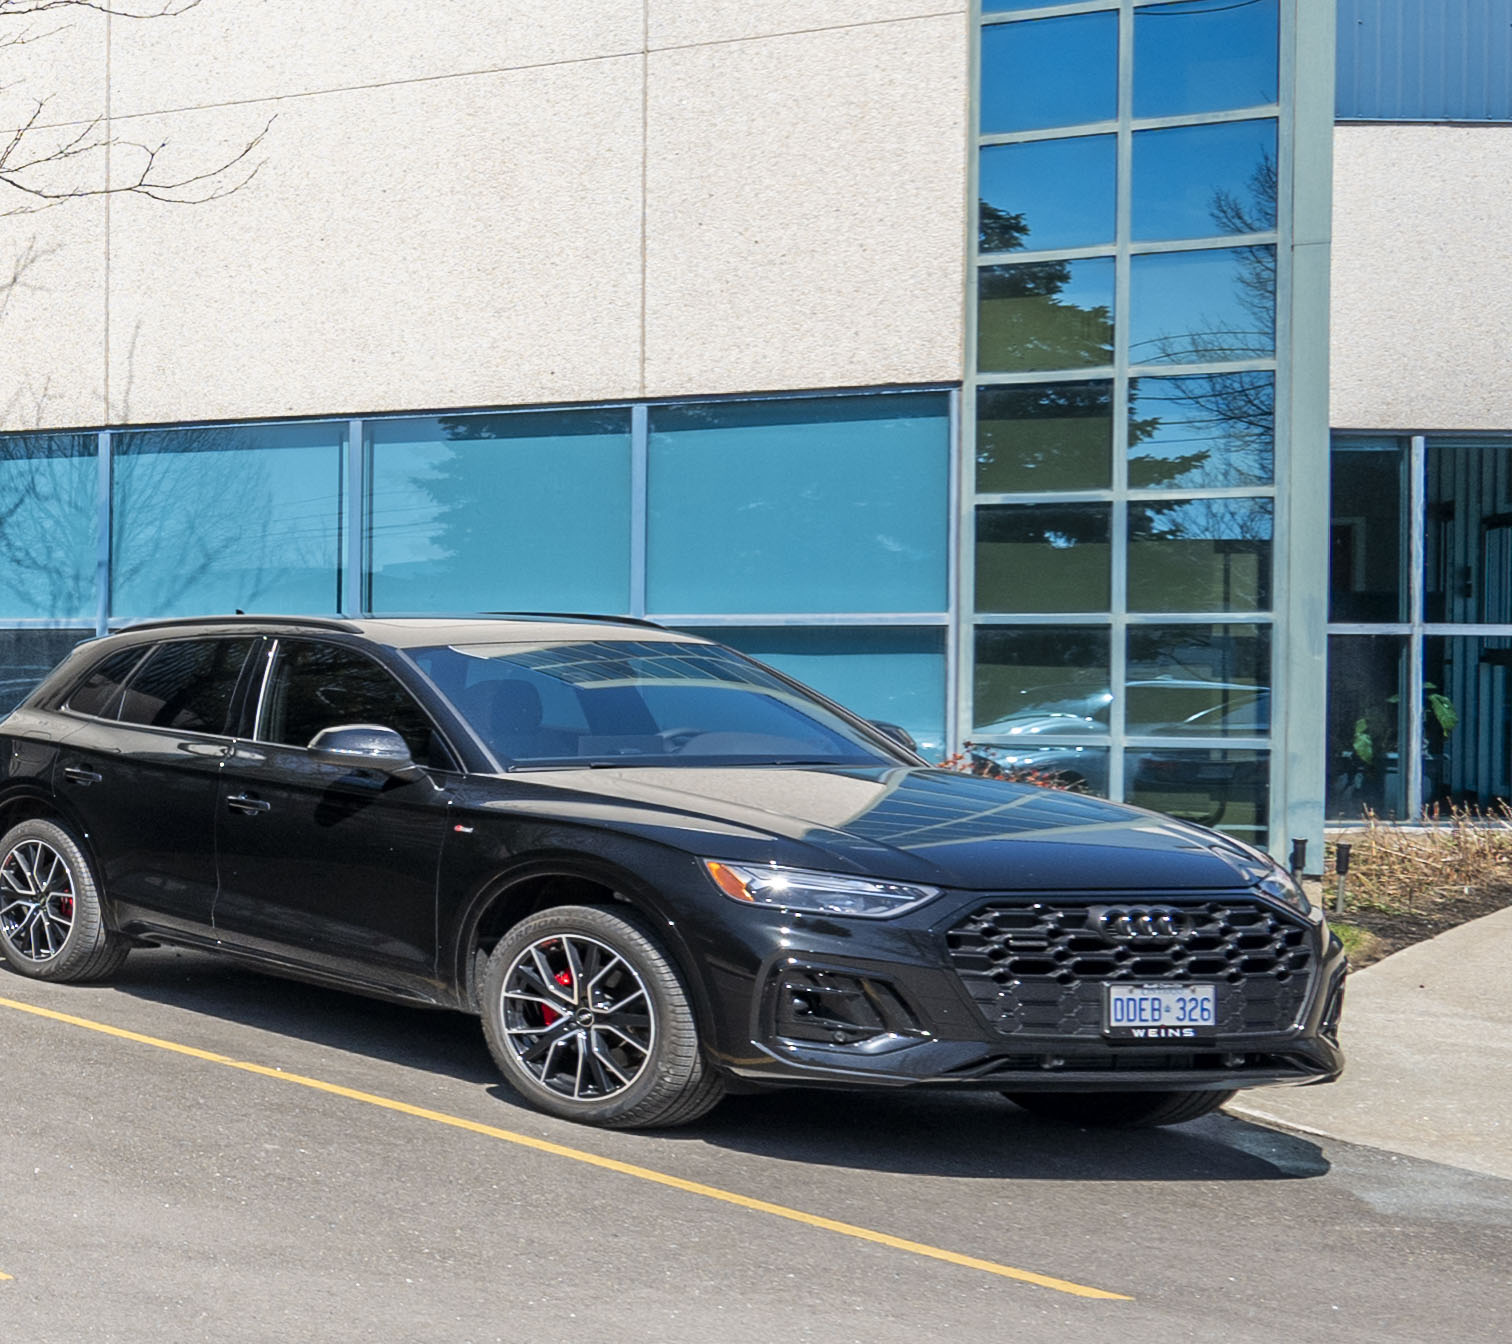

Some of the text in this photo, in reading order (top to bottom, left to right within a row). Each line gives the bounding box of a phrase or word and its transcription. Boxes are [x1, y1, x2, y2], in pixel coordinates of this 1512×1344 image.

[1114, 997, 1211, 1022] DDEB 326
[1130, 1028, 1195, 1038] WEINS
